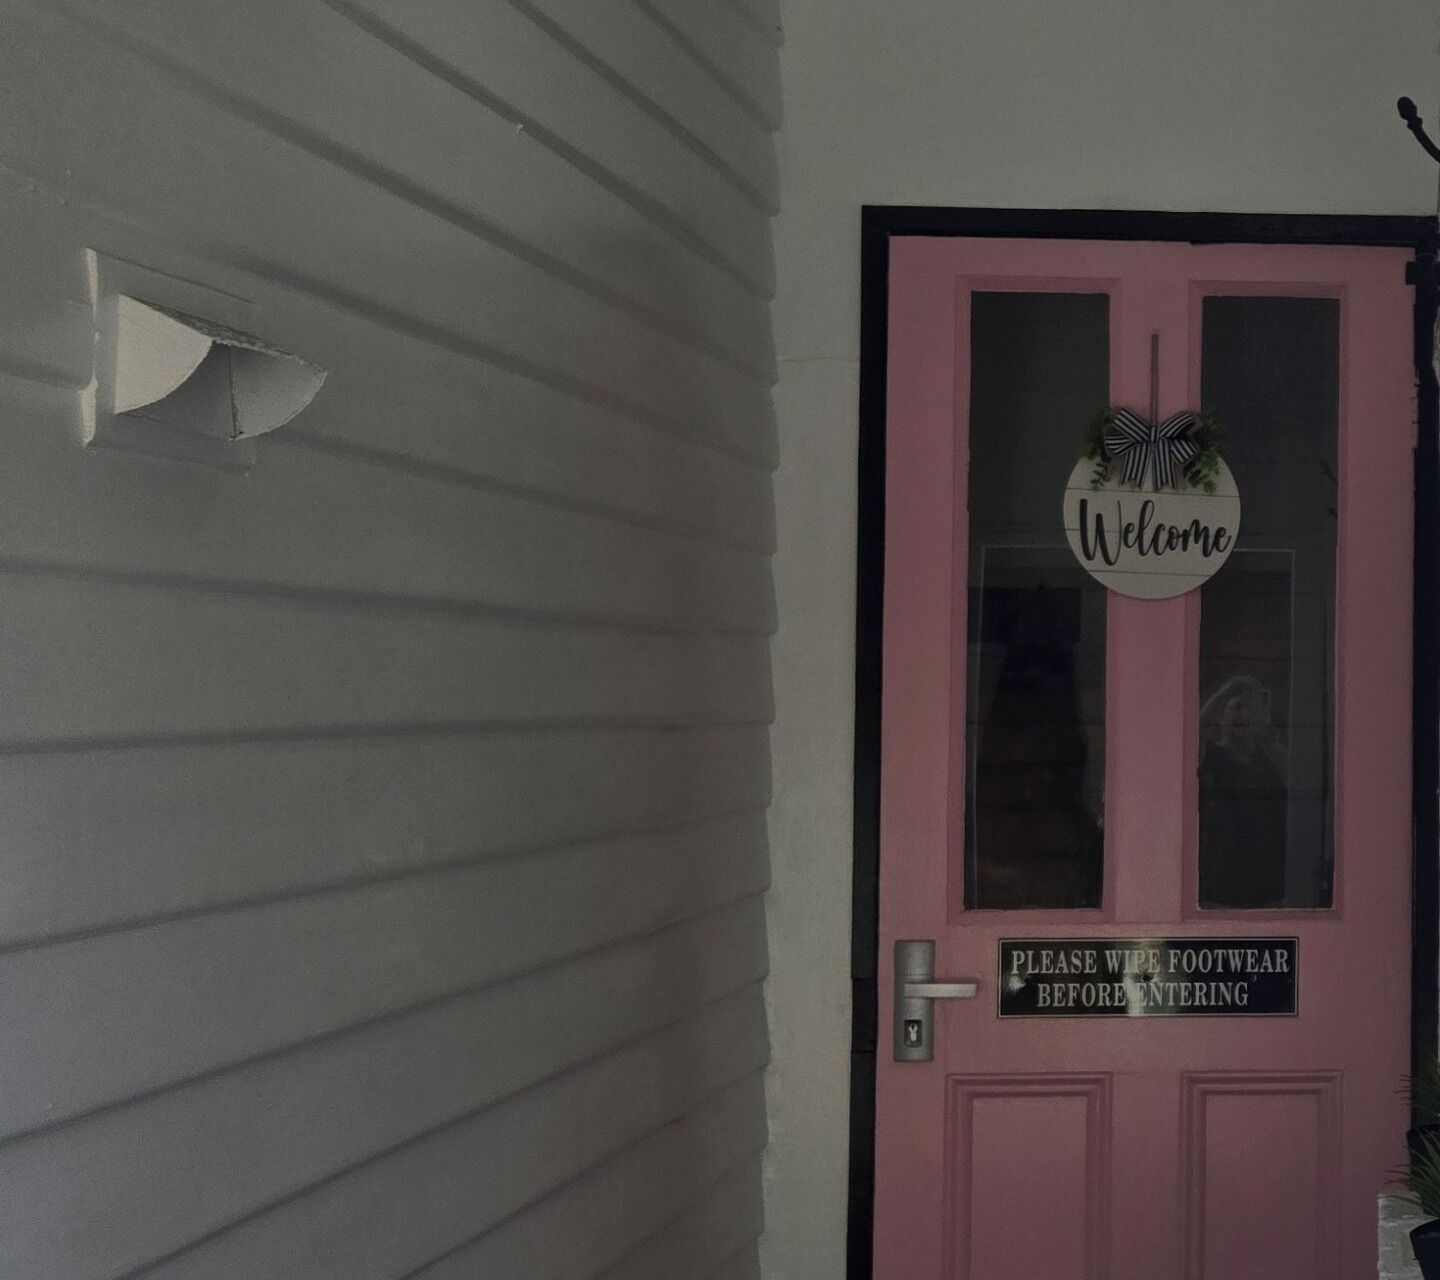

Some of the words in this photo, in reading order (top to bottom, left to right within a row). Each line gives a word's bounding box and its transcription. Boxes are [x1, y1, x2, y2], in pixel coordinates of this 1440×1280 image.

[1079, 498, 1232, 566] Welcome
[1011, 949, 1097, 975] PLEASE
[1104, 949, 1162, 974] WIPE
[1168, 948, 1290, 974] FOOTWEAR
[1037, 982, 1127, 1008] BEFORE
[1138, 981, 1249, 1007] ENTERING
